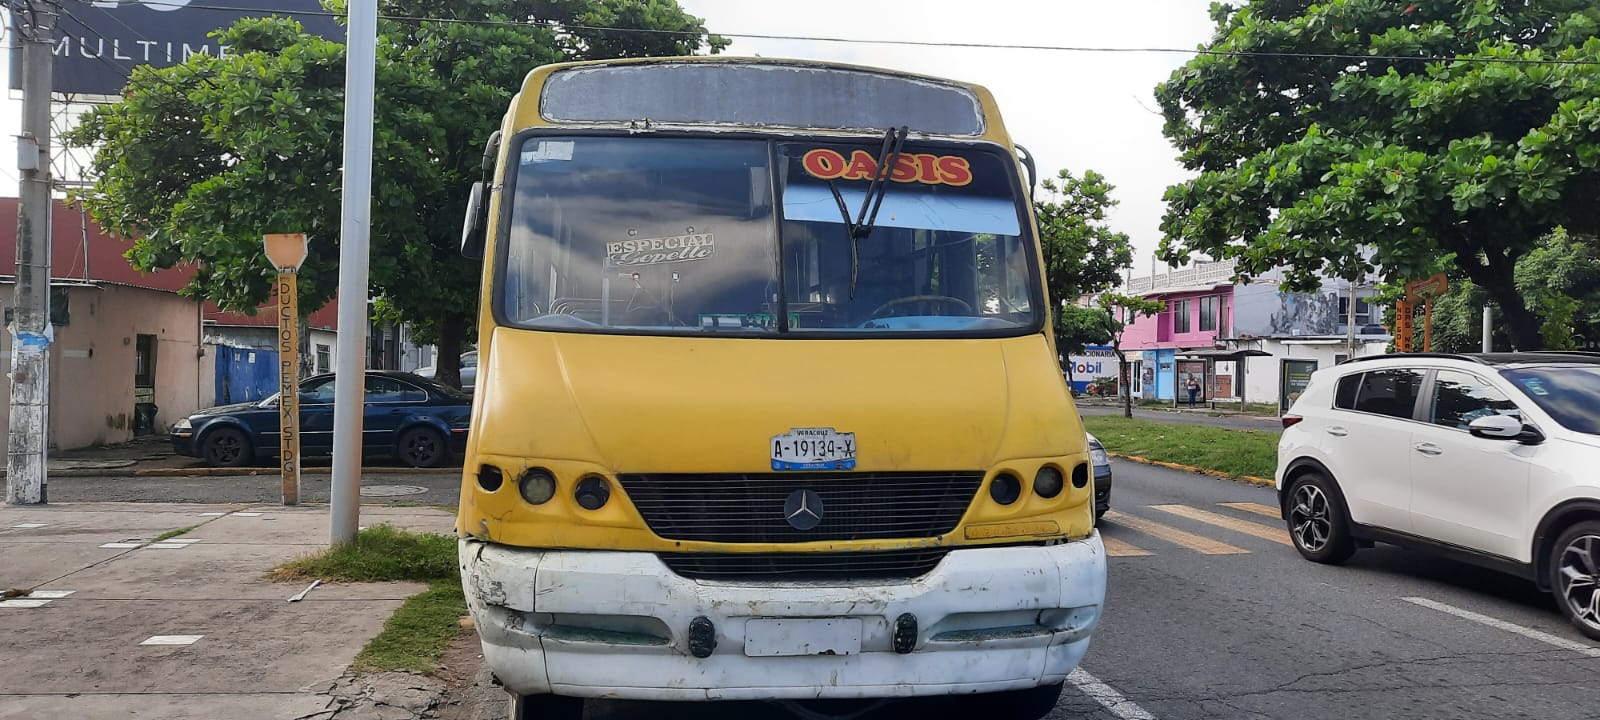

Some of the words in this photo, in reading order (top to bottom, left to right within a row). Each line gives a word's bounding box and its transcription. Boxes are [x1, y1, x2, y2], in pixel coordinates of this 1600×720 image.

[803, 149, 972, 186] OASIS
[609, 233, 713, 254] ESPECIAL
[280, 283, 292, 353] DUCTOS
[281, 360, 292, 419] PEMEX
[774, 440, 853, 457] A-19134-X
